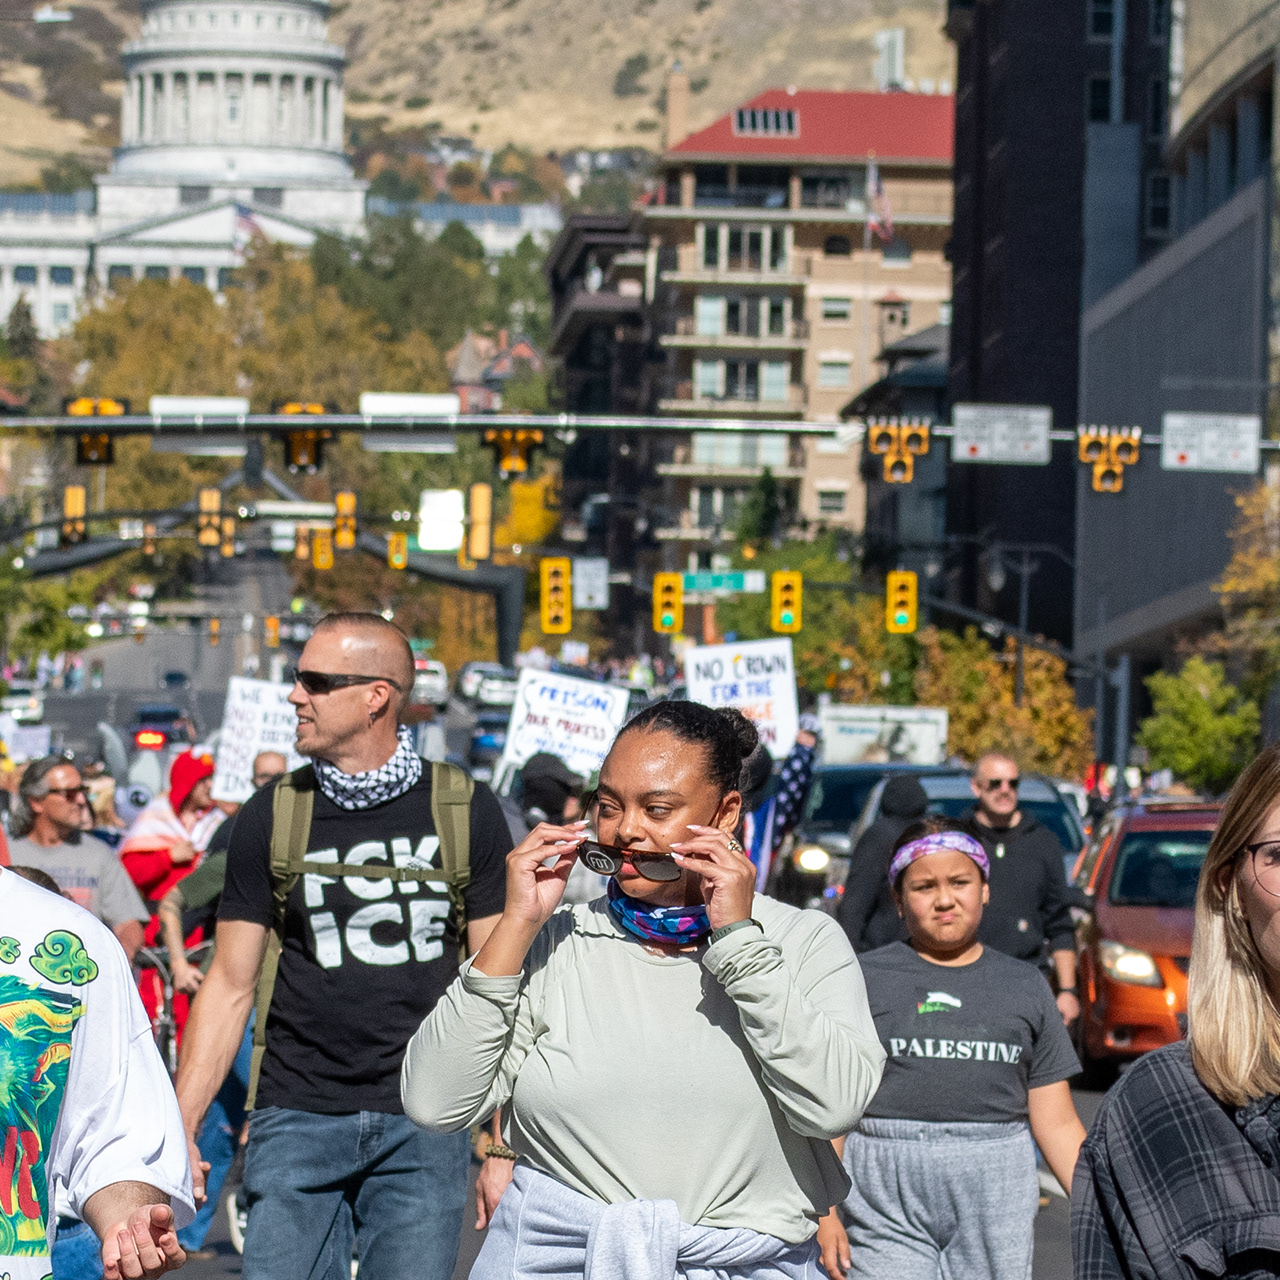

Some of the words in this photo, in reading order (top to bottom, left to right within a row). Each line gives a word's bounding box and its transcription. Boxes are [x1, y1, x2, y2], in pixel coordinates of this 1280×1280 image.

[695, 657, 724, 682] NO
[732, 654, 787, 680] CROWN
[303, 835, 449, 908] FCK
[309, 899, 451, 969] ICE
[889, 1037, 1023, 1065] PALESTINE
